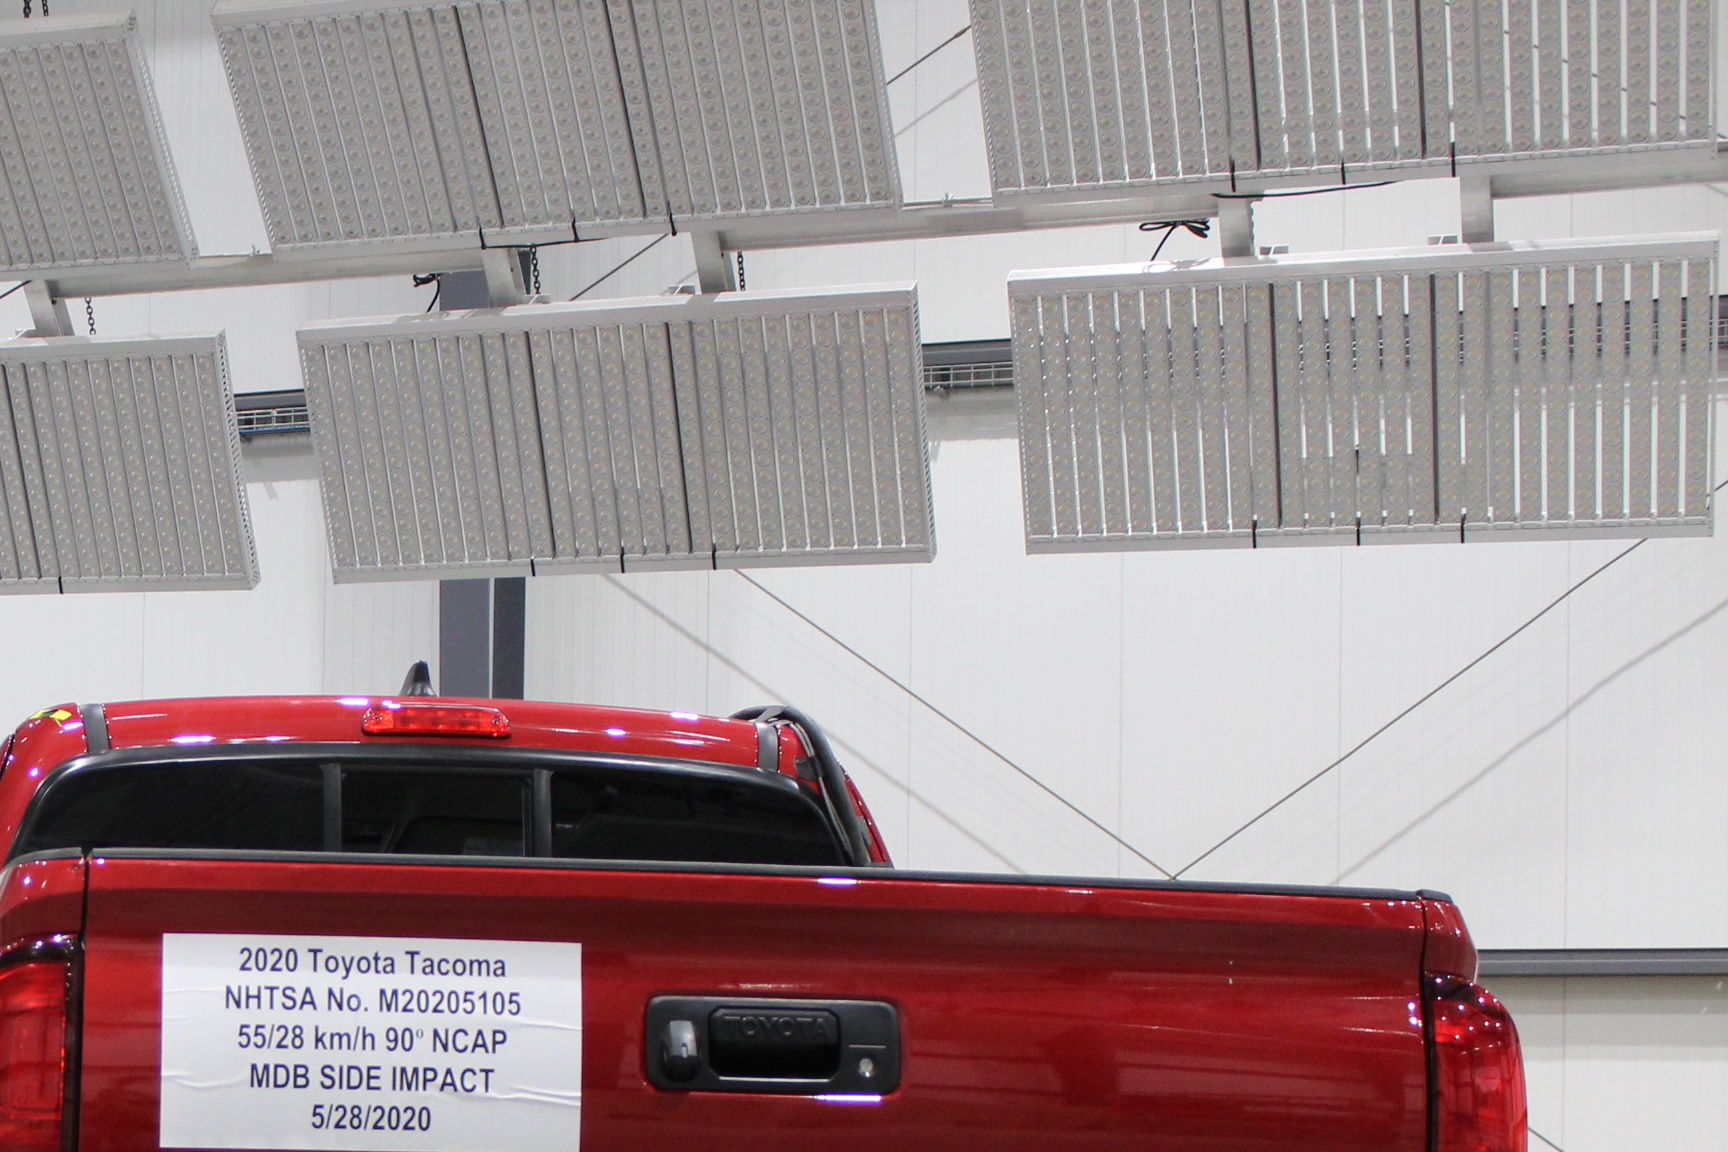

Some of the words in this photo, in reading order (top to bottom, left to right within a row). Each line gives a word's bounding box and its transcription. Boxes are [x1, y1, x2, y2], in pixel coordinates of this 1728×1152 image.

[239, 947, 298, 972] 2020
[307, 948, 396, 980] Toyota
[404, 950, 506, 977] Tacoma
[225, 985, 318, 1011] NHTSA
[327, 987, 369, 1012] No.
[379, 987, 521, 1016] M20205105
[238, 1023, 305, 1050] 55/28
[314, 1025, 376, 1051] km/h
[432, 1027, 508, 1054] NCAP
[249, 1063, 310, 1089] MDB
[319, 1064, 382, 1091] SIDE
[392, 1066, 495, 1093] IMPACT
[311, 1103, 432, 1131] 5/28/2020
